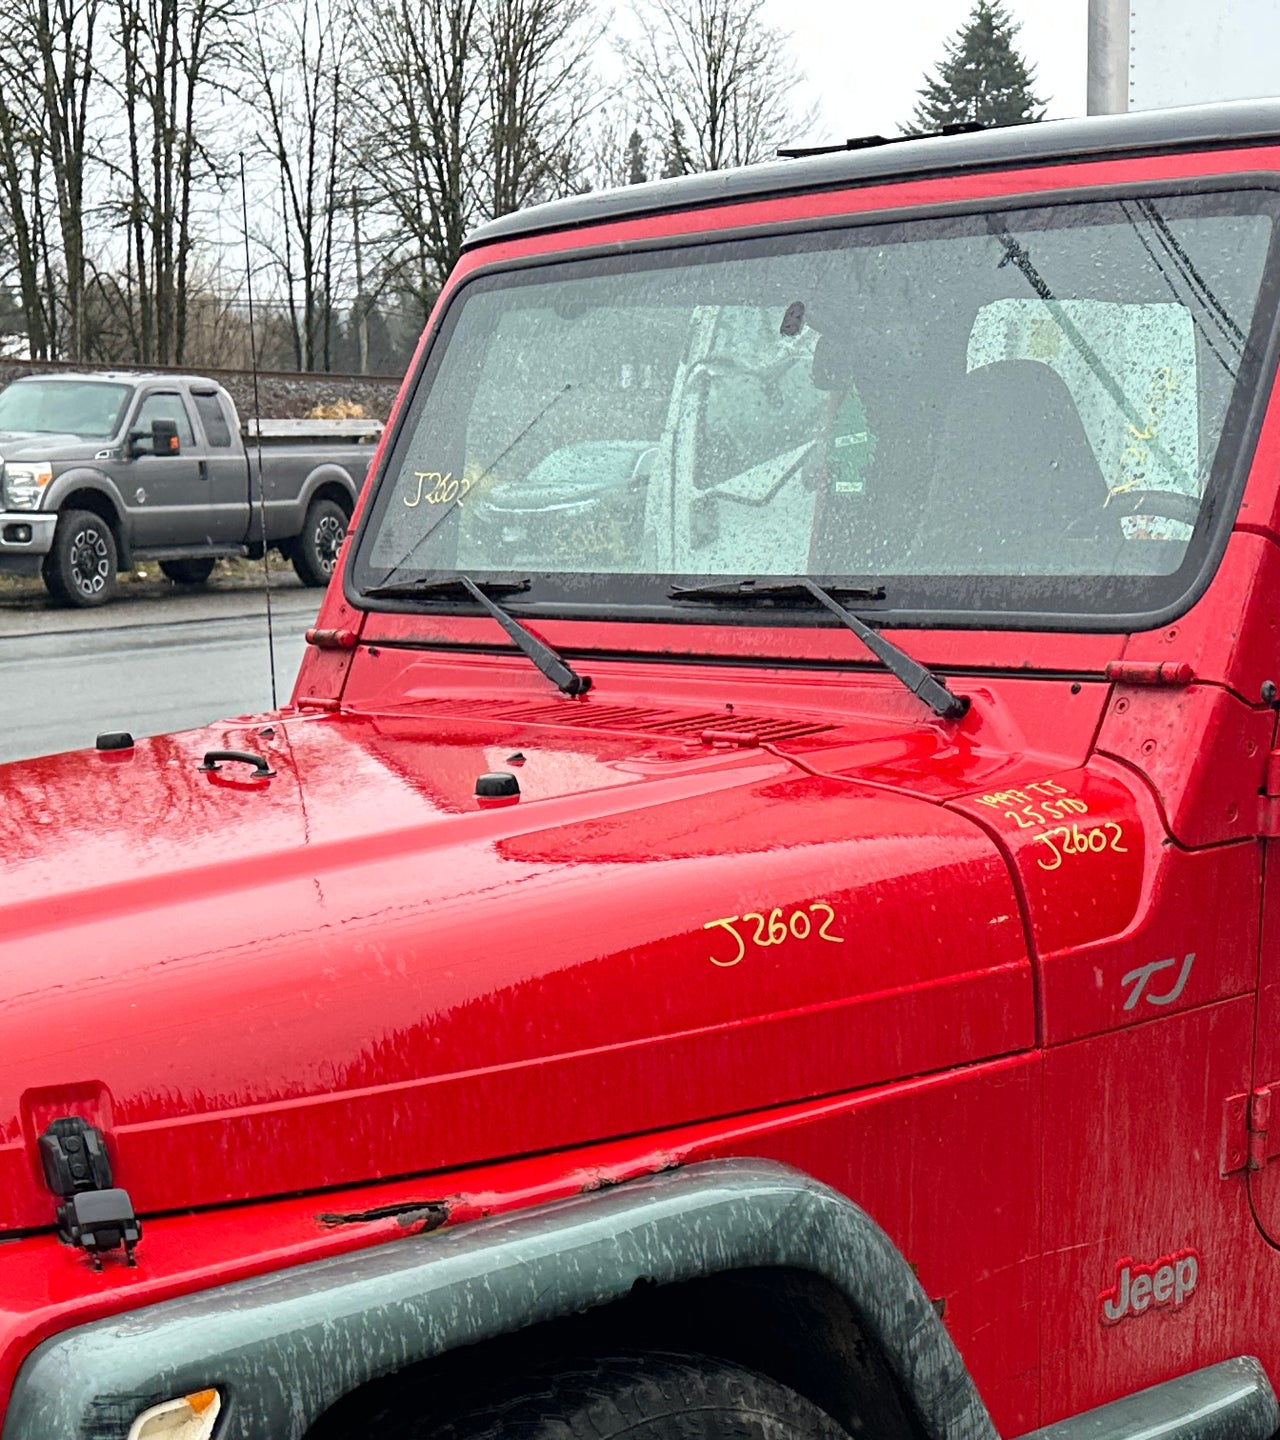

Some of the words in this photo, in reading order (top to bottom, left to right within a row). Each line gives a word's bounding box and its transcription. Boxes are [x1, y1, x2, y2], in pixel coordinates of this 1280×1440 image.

[403, 471, 471, 507] J2602
[1025, 780, 1067, 796] TJ
[1041, 798, 1088, 819] STD
[1033, 822, 1128, 870] J2602
[703, 903, 845, 967] J2602
[1121, 952, 1196, 1011] TJ
[1103, 1255, 1199, 1320] Jeep
